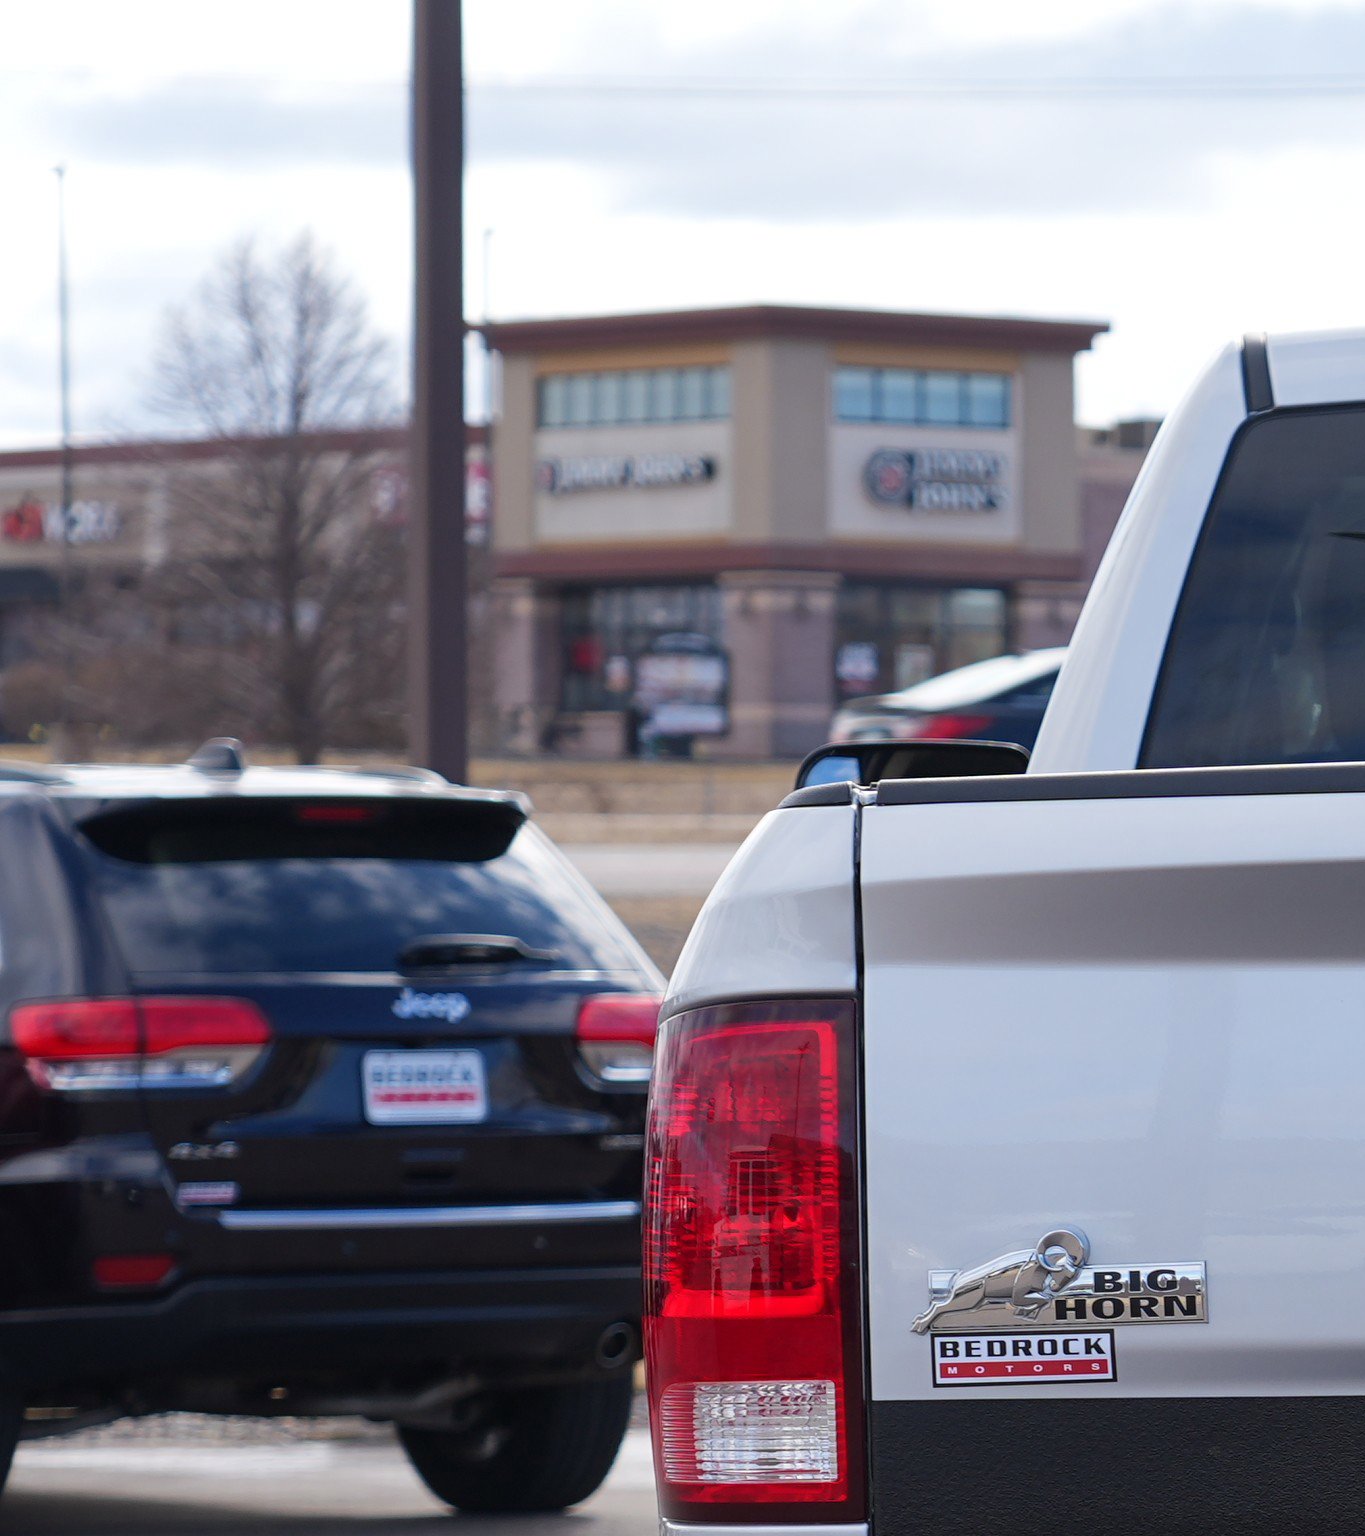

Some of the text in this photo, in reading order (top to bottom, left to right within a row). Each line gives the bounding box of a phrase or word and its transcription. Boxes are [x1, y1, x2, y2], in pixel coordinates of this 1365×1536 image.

[391, 987, 471, 1023] Jeep
[1093, 1269, 1178, 1293] BIG
[1055, 1296, 1197, 1320] HORN
[939, 1338, 1106, 1358] BEDROCK
[947, 1363, 1100, 1375] MOTORS
